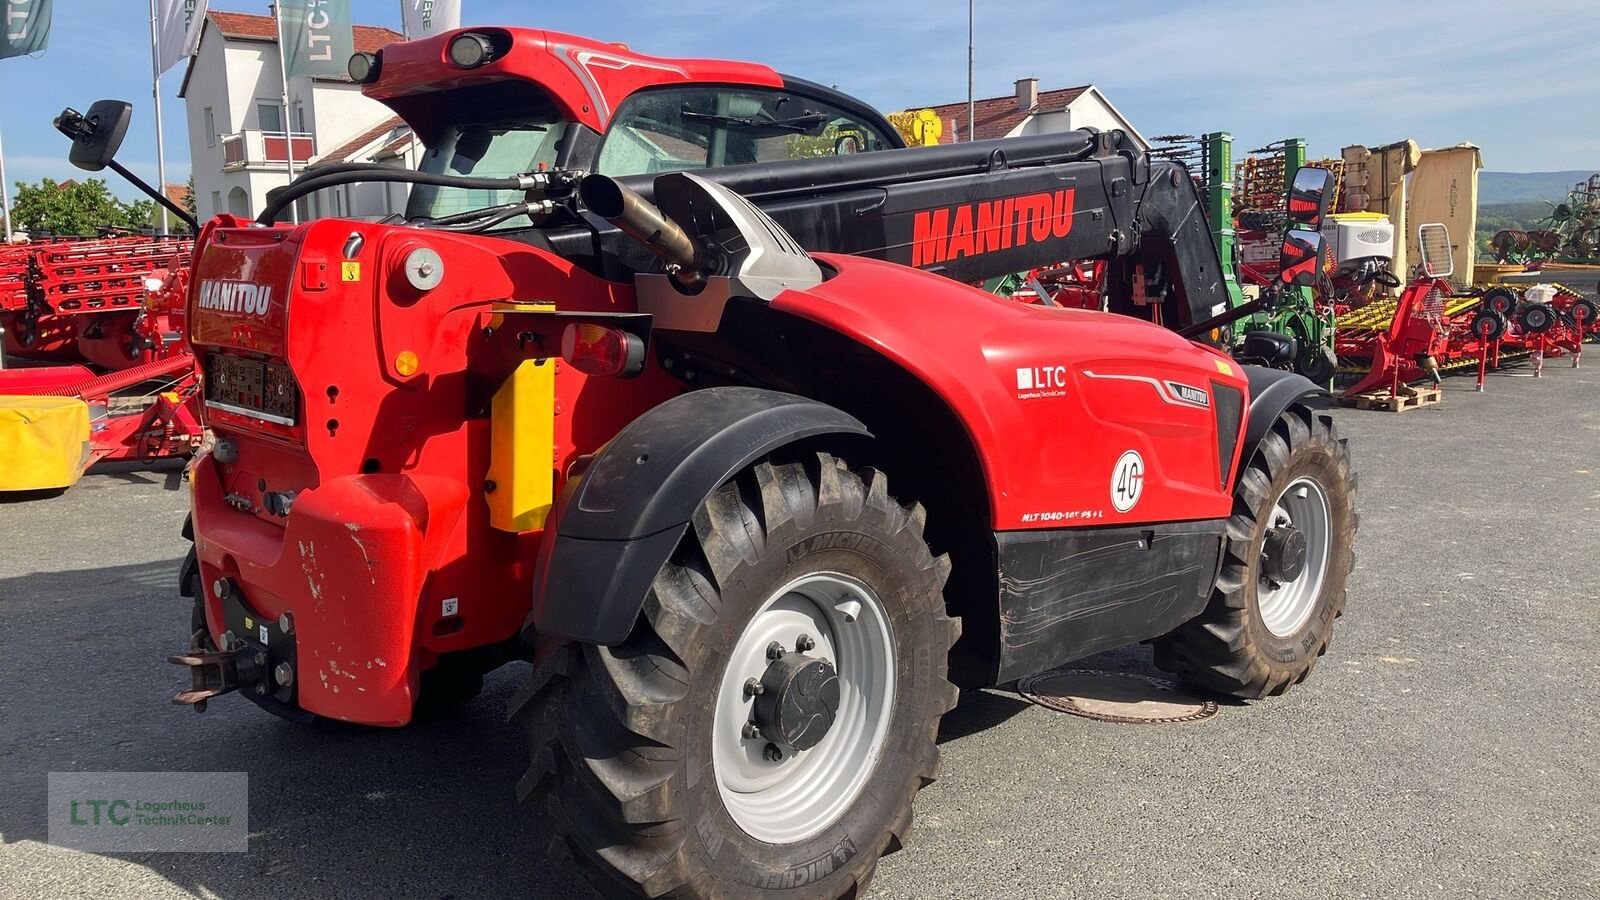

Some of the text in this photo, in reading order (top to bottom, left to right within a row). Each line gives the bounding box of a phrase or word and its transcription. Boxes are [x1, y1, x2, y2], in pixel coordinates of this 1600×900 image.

[307, 10, 332, 61] LTC
[912, 188, 1076, 268] MANITOU
[199, 281, 272, 316] MANITOU
[1034, 366, 1066, 388] LTC
[1181, 386, 1207, 404] MANITOU
[1117, 462, 1138, 501] 40
